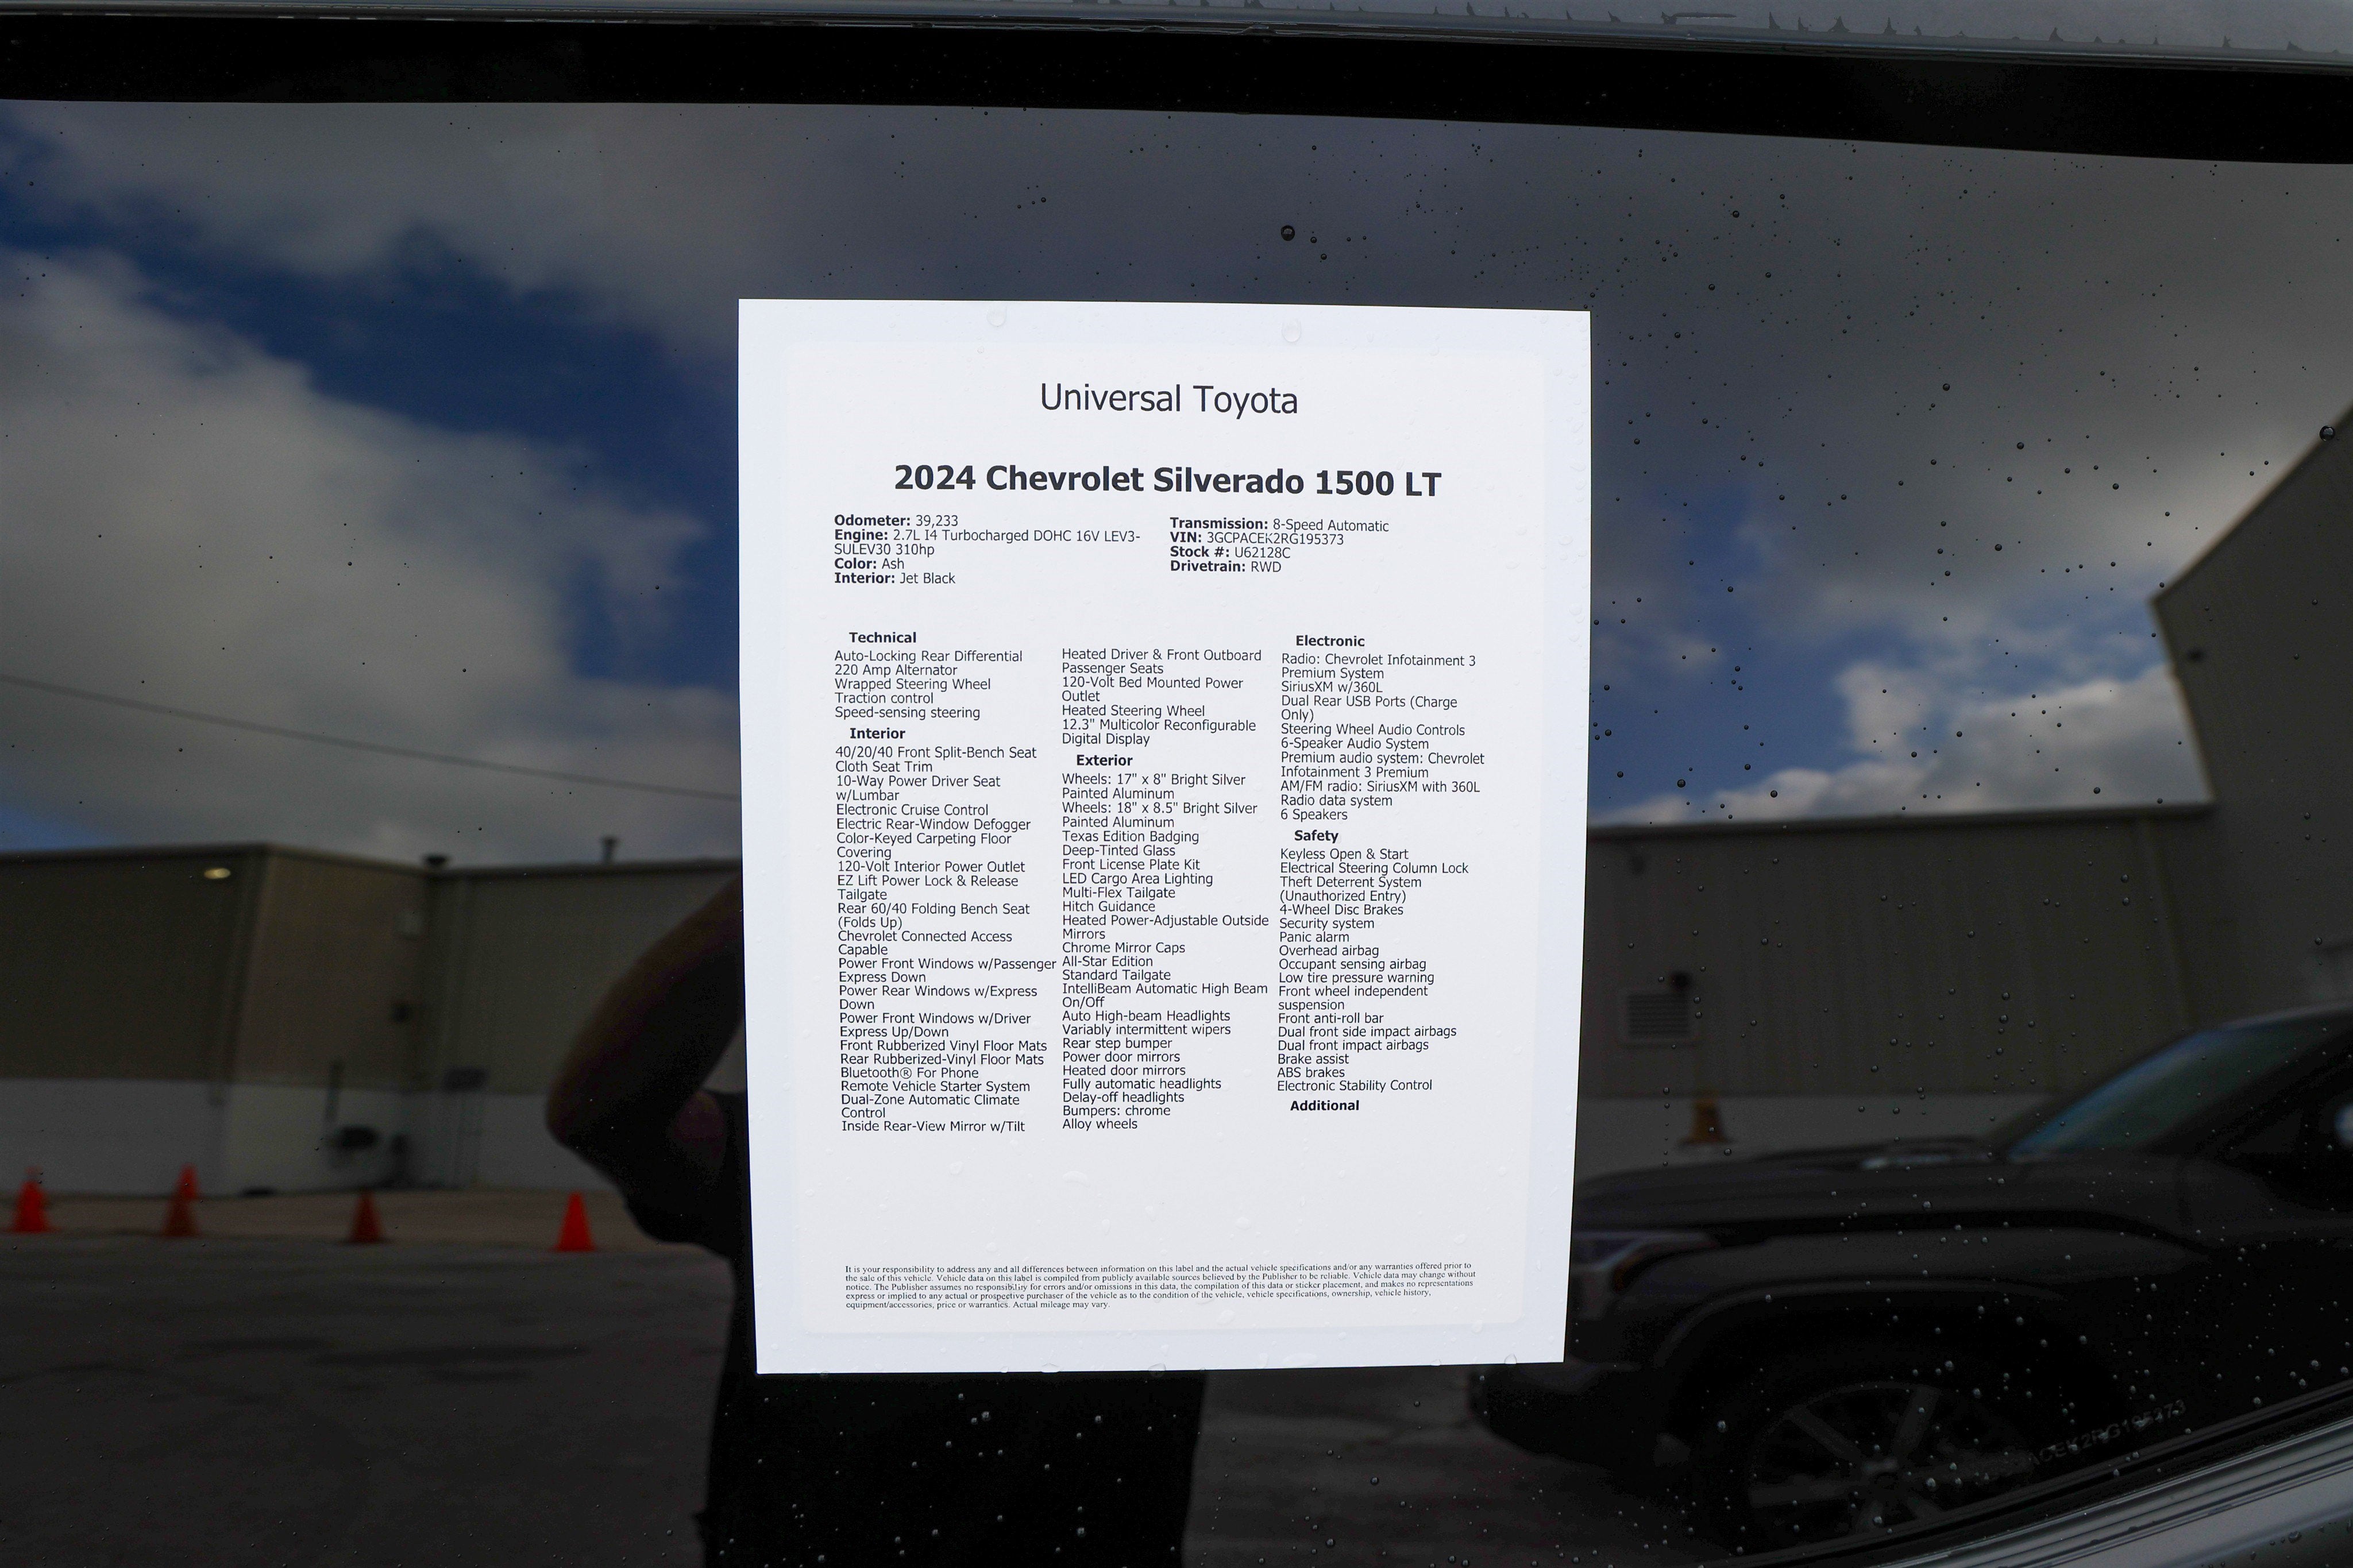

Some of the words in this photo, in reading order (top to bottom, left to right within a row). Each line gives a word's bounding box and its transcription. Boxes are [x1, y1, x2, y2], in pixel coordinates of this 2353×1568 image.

[1042, 383, 1180, 411] Universal
[1193, 385, 1297, 419] Toyota
[895, 464, 976, 490] 2024
[986, 465, 1144, 492] Chevrolet
[1154, 466, 1303, 494] Silverado
[1317, 470, 1394, 496] 1500
[1406, 472, 1442, 496] LT
[834, 514, 910, 526] Odometer:
[916, 515, 958, 528] 39,233
[1170, 517, 1267, 530] Transmission:
[1273, 518, 1322, 533] 8-Speed
[1328, 520, 1388, 531] Automatic
[835, 528, 888, 543] Engine:
[893, 529, 920, 540] 2.7L
[925, 529, 938, 540] I4
[942, 529, 1028, 543] Turbocharged
[1034, 530, 1071, 541] DOHC
[1077, 530, 1100, 542] 16V
[1105, 530, 1140, 542] LEV3-
[1170, 531, 1201, 542] VIN:
[1207, 531, 1344, 545] 3GCPACEK2RG195373
[834, 543, 890, 555] SULEV30
[896, 543, 935, 558] 310hp
[1170, 546, 1209, 557] Stock
[1214, 546, 1229, 557] #:
[1235, 546, 1290, 558] U62128C
[834, 557, 876, 569] Color:
[881, 558, 904, 569] Ash
[1171, 559, 1245, 571] Drivetrain:
[1251, 561, 1281, 572] RWD
[834, 572, 894, 584] Interior:
[900, 573, 918, 584] Jet
[924, 572, 955, 584] Black
[848, 631, 916, 643] Technical
[1296, 634, 1365, 646] Electronic
[835, 663, 858, 675] 220
[862, 664, 890, 678] Amp
[895, 664, 958, 675] Alternator
[1062, 662, 1125, 676] Passenger
[1130, 662, 1163, 674] Seats
[1282, 667, 1335, 678] Premium
[1340, 667, 1384, 681] System
[835, 706, 925, 720] Speed-sensing
[931, 706, 979, 721] steering
[1063, 704, 1106, 716] Heated
[1110, 704, 1162, 719] Steering
[1167, 705, 1204, 716] Wheel
[1281, 709, 1314, 723] Only)
[850, 727, 905, 739] Interior
[1077, 754, 1133, 766] Exterior
[1282, 751, 1334, 763] Premium
[1340, 751, 1372, 763] audio
[1377, 752, 1422, 766] system:
[1428, 752, 1484, 764] Chevrolet
[837, 775, 884, 789] 10-Way
[889, 775, 927, 786] Power
[932, 775, 969, 787] Driver
[973, 775, 1001, 787] Seat
[1062, 773, 1110, 784] Wheels:
[1117, 773, 1136, 784] 17"
[1141, 776, 1148, 785] x
[1153, 773, 1166, 785] 8"
[1171, 773, 1208, 787] Bright
[1212, 773, 1245, 785] Silver
[1281, 794, 1314, 805] Radio
[1319, 794, 1345, 806] data
[1351, 795, 1392, 809] system
[837, 817, 881, 829] Electric
[886, 818, 969, 829] Rear-Window
[974, 818, 1031, 833] Defogger
[1063, 816, 1108, 827] Painted
[1112, 816, 1174, 828] Aluminum
[1294, 829, 1338, 844] Safety
[839, 860, 890, 872] 120-Volt
[894, 861, 940, 872] Interior
[945, 861, 983, 872] Power
[987, 861, 1025, 872] Outlet
[1063, 859, 1095, 870] Front
[1100, 858, 1144, 870] License
[1150, 859, 1179, 870] Plate
[1185, 859, 1200, 870] Kit
[1280, 862, 1334, 873] Electrical
[1338, 862, 1388, 876] Steering
[1392, 862, 1437, 874] Column
[1442, 862, 1468, 874] Lock
[838, 902, 866, 914] Rear
[871, 902, 907, 916] 60/40
[912, 902, 955, 917] Folding
[961, 903, 997, 914] Bench
[1003, 903, 1030, 914] Seat
[1063, 900, 1093, 912] Hitch
[1098, 901, 1155, 912] Guidance
[1279, 903, 1329, 915] 4-Wheel
[1334, 904, 1359, 915] Disc
[1364, 903, 1403, 915] Brakes
[838, 944, 888, 957] Capable
[1062, 941, 1110, 953] Chrome
[1115, 942, 1151, 953] Mirror
[1156, 942, 1185, 955] Caps
[1279, 944, 1337, 956] Overhead
[1342, 944, 1379, 959] airbag
[839, 985, 878, 996] Power
[882, 985, 911, 996] Rear
[915, 985, 970, 996] Windows
[974, 985, 1037, 999] w/Express
[1063, 983, 1131, 994] IntelliBeam
[1135, 983, 1197, 994] Automatic
[1202, 982, 1229, 997] High
[1235, 983, 1267, 994] Beam
[1279, 986, 1310, 997] Front
[1314, 985, 1349, 996] wheel
[1355, 984, 1428, 999] independent
[840, 1026, 887, 1040] Express
[892, 1026, 948, 1039] Up/Down
[1290, 1100, 1359, 1111] Additional
[882, 1266, 935, 1275] responsibility
[1280, 1264, 1330, 1272] specifications
[846, 1301, 934, 1310] equipment/accessories,
[1040, 1301, 1070, 1310] mileage
